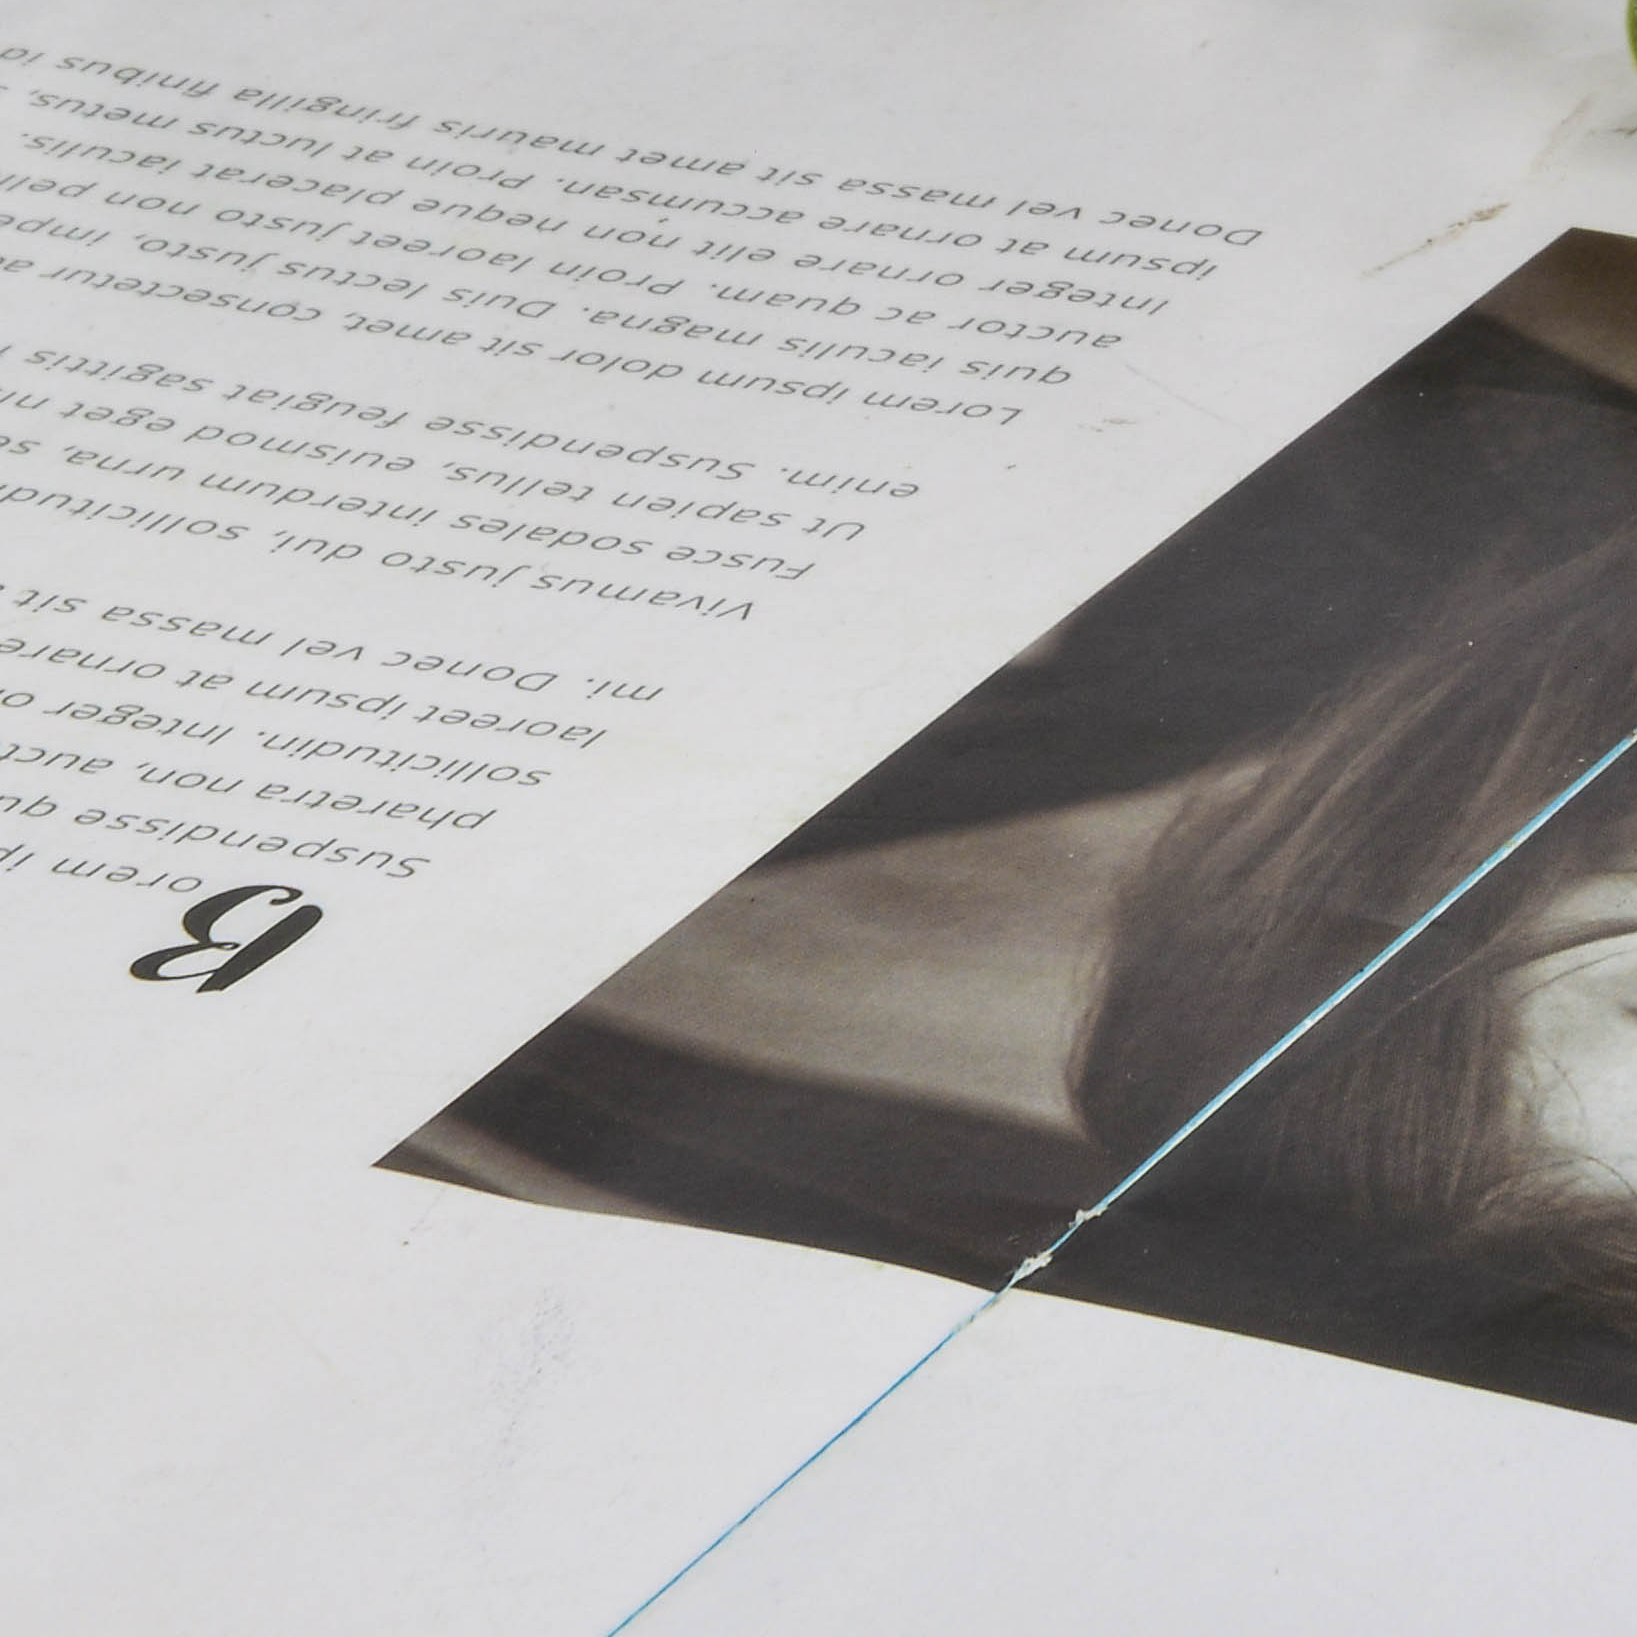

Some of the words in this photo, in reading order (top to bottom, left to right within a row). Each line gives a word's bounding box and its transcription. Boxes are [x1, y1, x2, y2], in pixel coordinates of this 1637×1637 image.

[55, 56, 221, 99] finibus
[29, 89, 180, 130] metus,
[232, 87, 421, 131] fringilla
[21, 132, 183, 175] iaculis.
[186, 121, 335, 159] luctus
[340, 145, 395, 164] at
[432, 119, 606, 157] mauris
[404, 155, 536, 190] Proin
[614, 147, 747, 176] amet
[755, 166, 824, 187] sit
[190, 162, 406, 206] placerat
[556, 177, 806, 225] accumsan.
[836, 177, 998, 209] massa
[103, 190, 202, 216] non
[411, 198, 569, 234] neque
[1004, 199, 1083, 221] vel
[213, 208, 354, 243] justo
[582, 222, 682, 250] non
[817, 215, 984, 248] ornare
[1098, 210, 1264, 247] Donec
[134, 233, 280, 273] justo,
[348, 230, 535, 274] laoreet
[691, 239, 777, 264] elit
[994, 237, 1051, 256] at
[1062, 246, 1219, 282] ipsum
[275, 261, 430, 301] lectus
[547, 260, 686, 296] Proin
[792, 253, 966, 287] ornare
[38, 266, 323, 322] consectetur
[441, 287, 558, 319] Duis
[710, 282, 862, 316] quam.
[977, 278, 1170, 317] Integer
[343, 311, 473, 346] amet,
[582, 306, 765, 347] magna.
[874, 306, 937, 325] ac
[946, 317, 1123, 349] auctor
[478, 336, 544, 358] sit
[548, 348, 685, 381] dolor
[776, 336, 945, 374] iaculis
[23, 350, 215, 393] sagittis
[696, 369, 851, 406] ipsum
[958, 360, 1072, 385] quis
[58, 401, 177, 433] eget
[221, 383, 410, 429] feugiat
[861, 390, 1024, 426] Lorem
[63, 444, 186, 482] urna,
[182, 424, 416, 472] euismod
[424, 415, 757, 481] Suspendisse
[198, 472, 439, 528] interdum
[442, 461, 595, 503] tellus,
[780, 467, 920, 499] enim.
[0, 483, 251, 541] sollicitud
[610, 491, 792, 528] sapien
[269, 529, 364, 563] dui,
[448, 514, 654, 556] sodales
[801, 516, 866, 542] Ut
[380, 551, 533, 589] justo
[664, 545, 816, 581] Fusce
[12, 588, 88, 614] sit
[529, 574, 755, 622] Vivamus
[100, 605, 275, 647] massa
[0, 637, 168, 680] ornare
[278, 636, 365, 662] vel
[174, 669, 235, 691] at
[380, 650, 560, 693] Donec
[585, 677, 665, 702] mi.
[244, 680, 409, 721] ipsum
[41, 700, 235, 746] Integer
[412, 704, 608, 750] laoreet
[256, 730, 552, 787] sollicitudin.
[135, 761, 245, 794] non,
[253, 782, 499, 831] pharetra
[72, 808, 432, 879] Suspendisse
